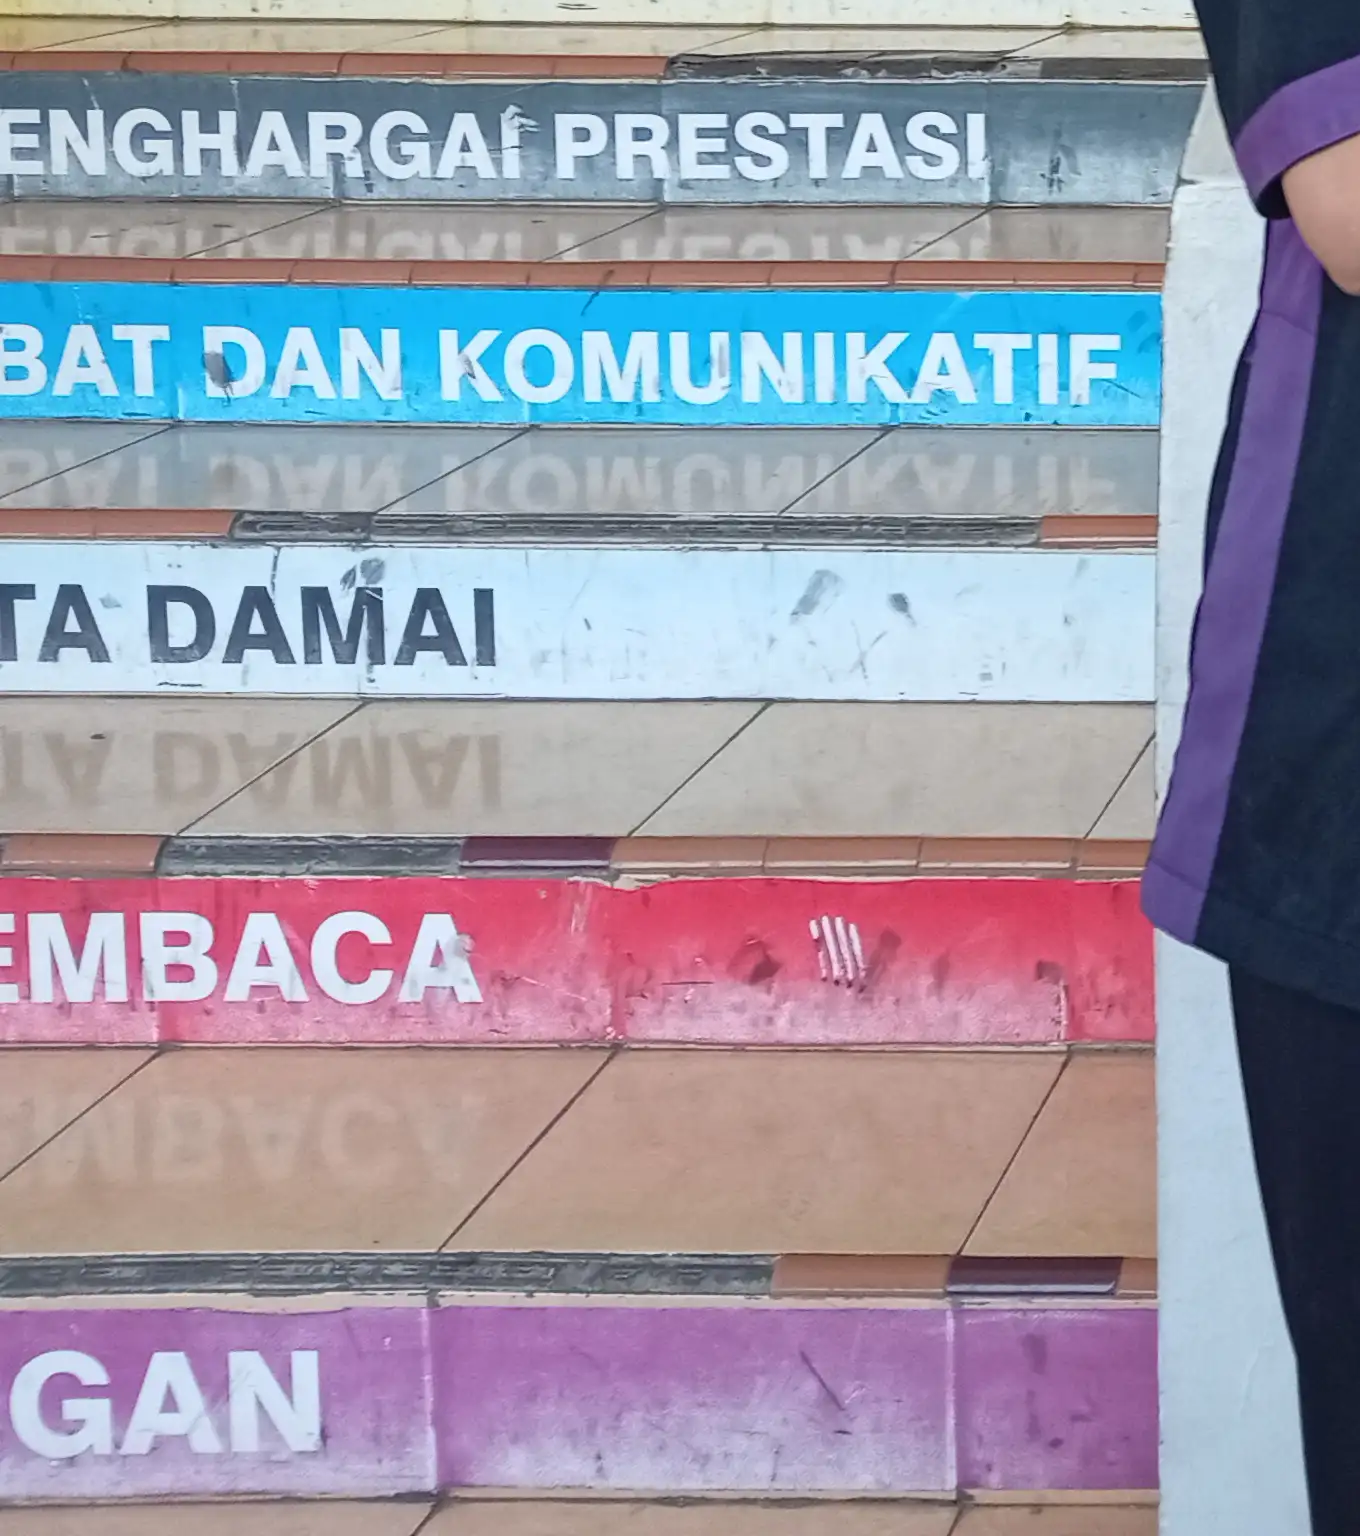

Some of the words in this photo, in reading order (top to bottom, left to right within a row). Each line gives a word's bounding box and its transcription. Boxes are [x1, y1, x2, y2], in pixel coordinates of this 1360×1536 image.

[0, 108, 525, 181] ENGHARGAI
[555, 112, 988, 180] PRESTASI
[0, 323, 170, 398] BAT
[203, 324, 403, 402] DAN
[439, 328, 1121, 406] KOMUNIKATIF
[146, 583, 497, 667] DAMAI
[9, 1349, 321, 1460] GAN
